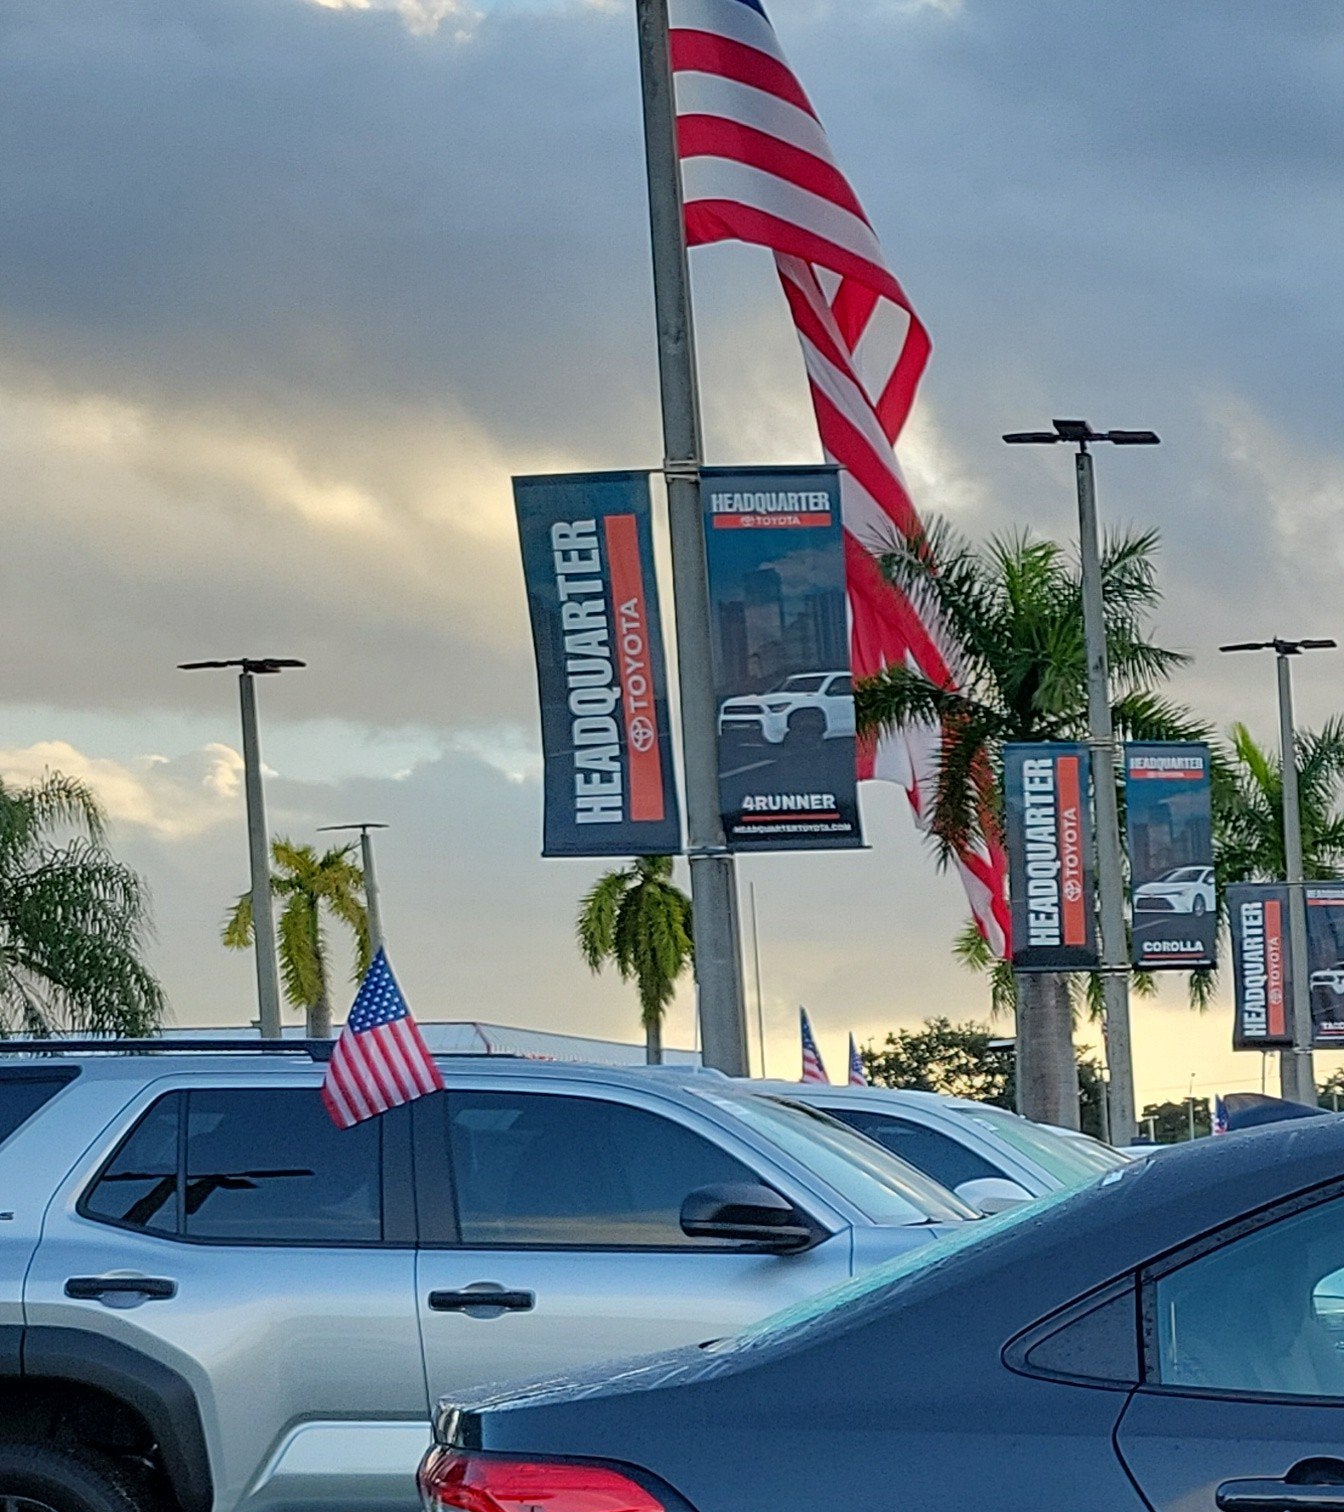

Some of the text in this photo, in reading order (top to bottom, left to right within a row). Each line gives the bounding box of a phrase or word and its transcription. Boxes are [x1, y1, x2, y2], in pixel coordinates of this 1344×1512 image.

[711, 492, 830, 514] HEADQUARTER
[757, 515, 801, 526] TOYOTA
[551, 518, 623, 825] HEADQUARTER
[619, 597, 647, 714] TOYOTA
[742, 794, 836, 811] 4RUNNER
[1023, 758, 1061, 946] HEADQUARTER
[1063, 807, 1079, 877] TOYOTA
[1143, 941, 1204, 952] COROLLA
[1241, 902, 1268, 1036] HEADQUARTER
[1270, 937, 1281, 989] TOYOTA
